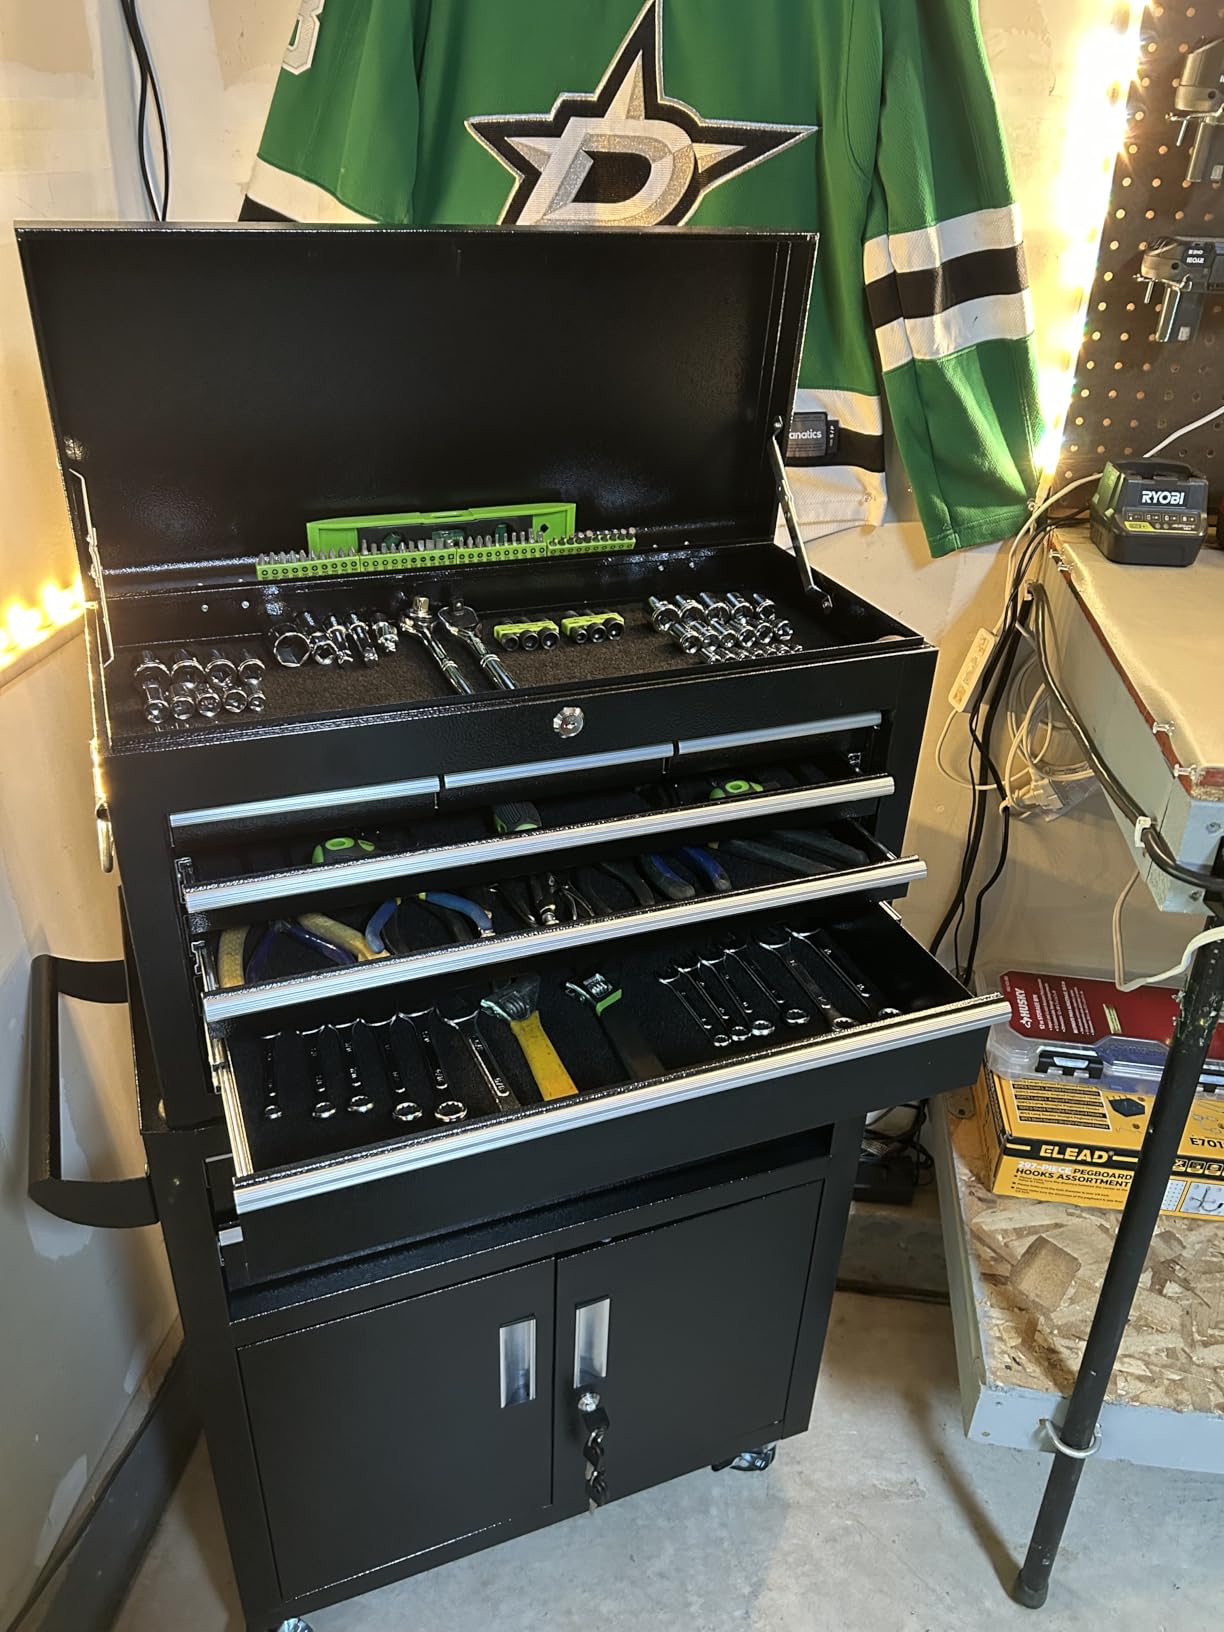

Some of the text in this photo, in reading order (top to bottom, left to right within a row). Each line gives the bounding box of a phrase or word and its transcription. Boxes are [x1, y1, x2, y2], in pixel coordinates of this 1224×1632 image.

[788, 428, 822, 439] anatics
[1141, 490, 1185, 505] RYOBI
[1014, 987, 1031, 1018] HUSKY
[1040, 1144, 1109, 1163] ELEAD
[1016, 1168, 1054, 1179] HOOKS
[1056, 1173, 1130, 1188] ASSORTMENT
[1073, 1168, 1133, 1181] PEGBOARD
